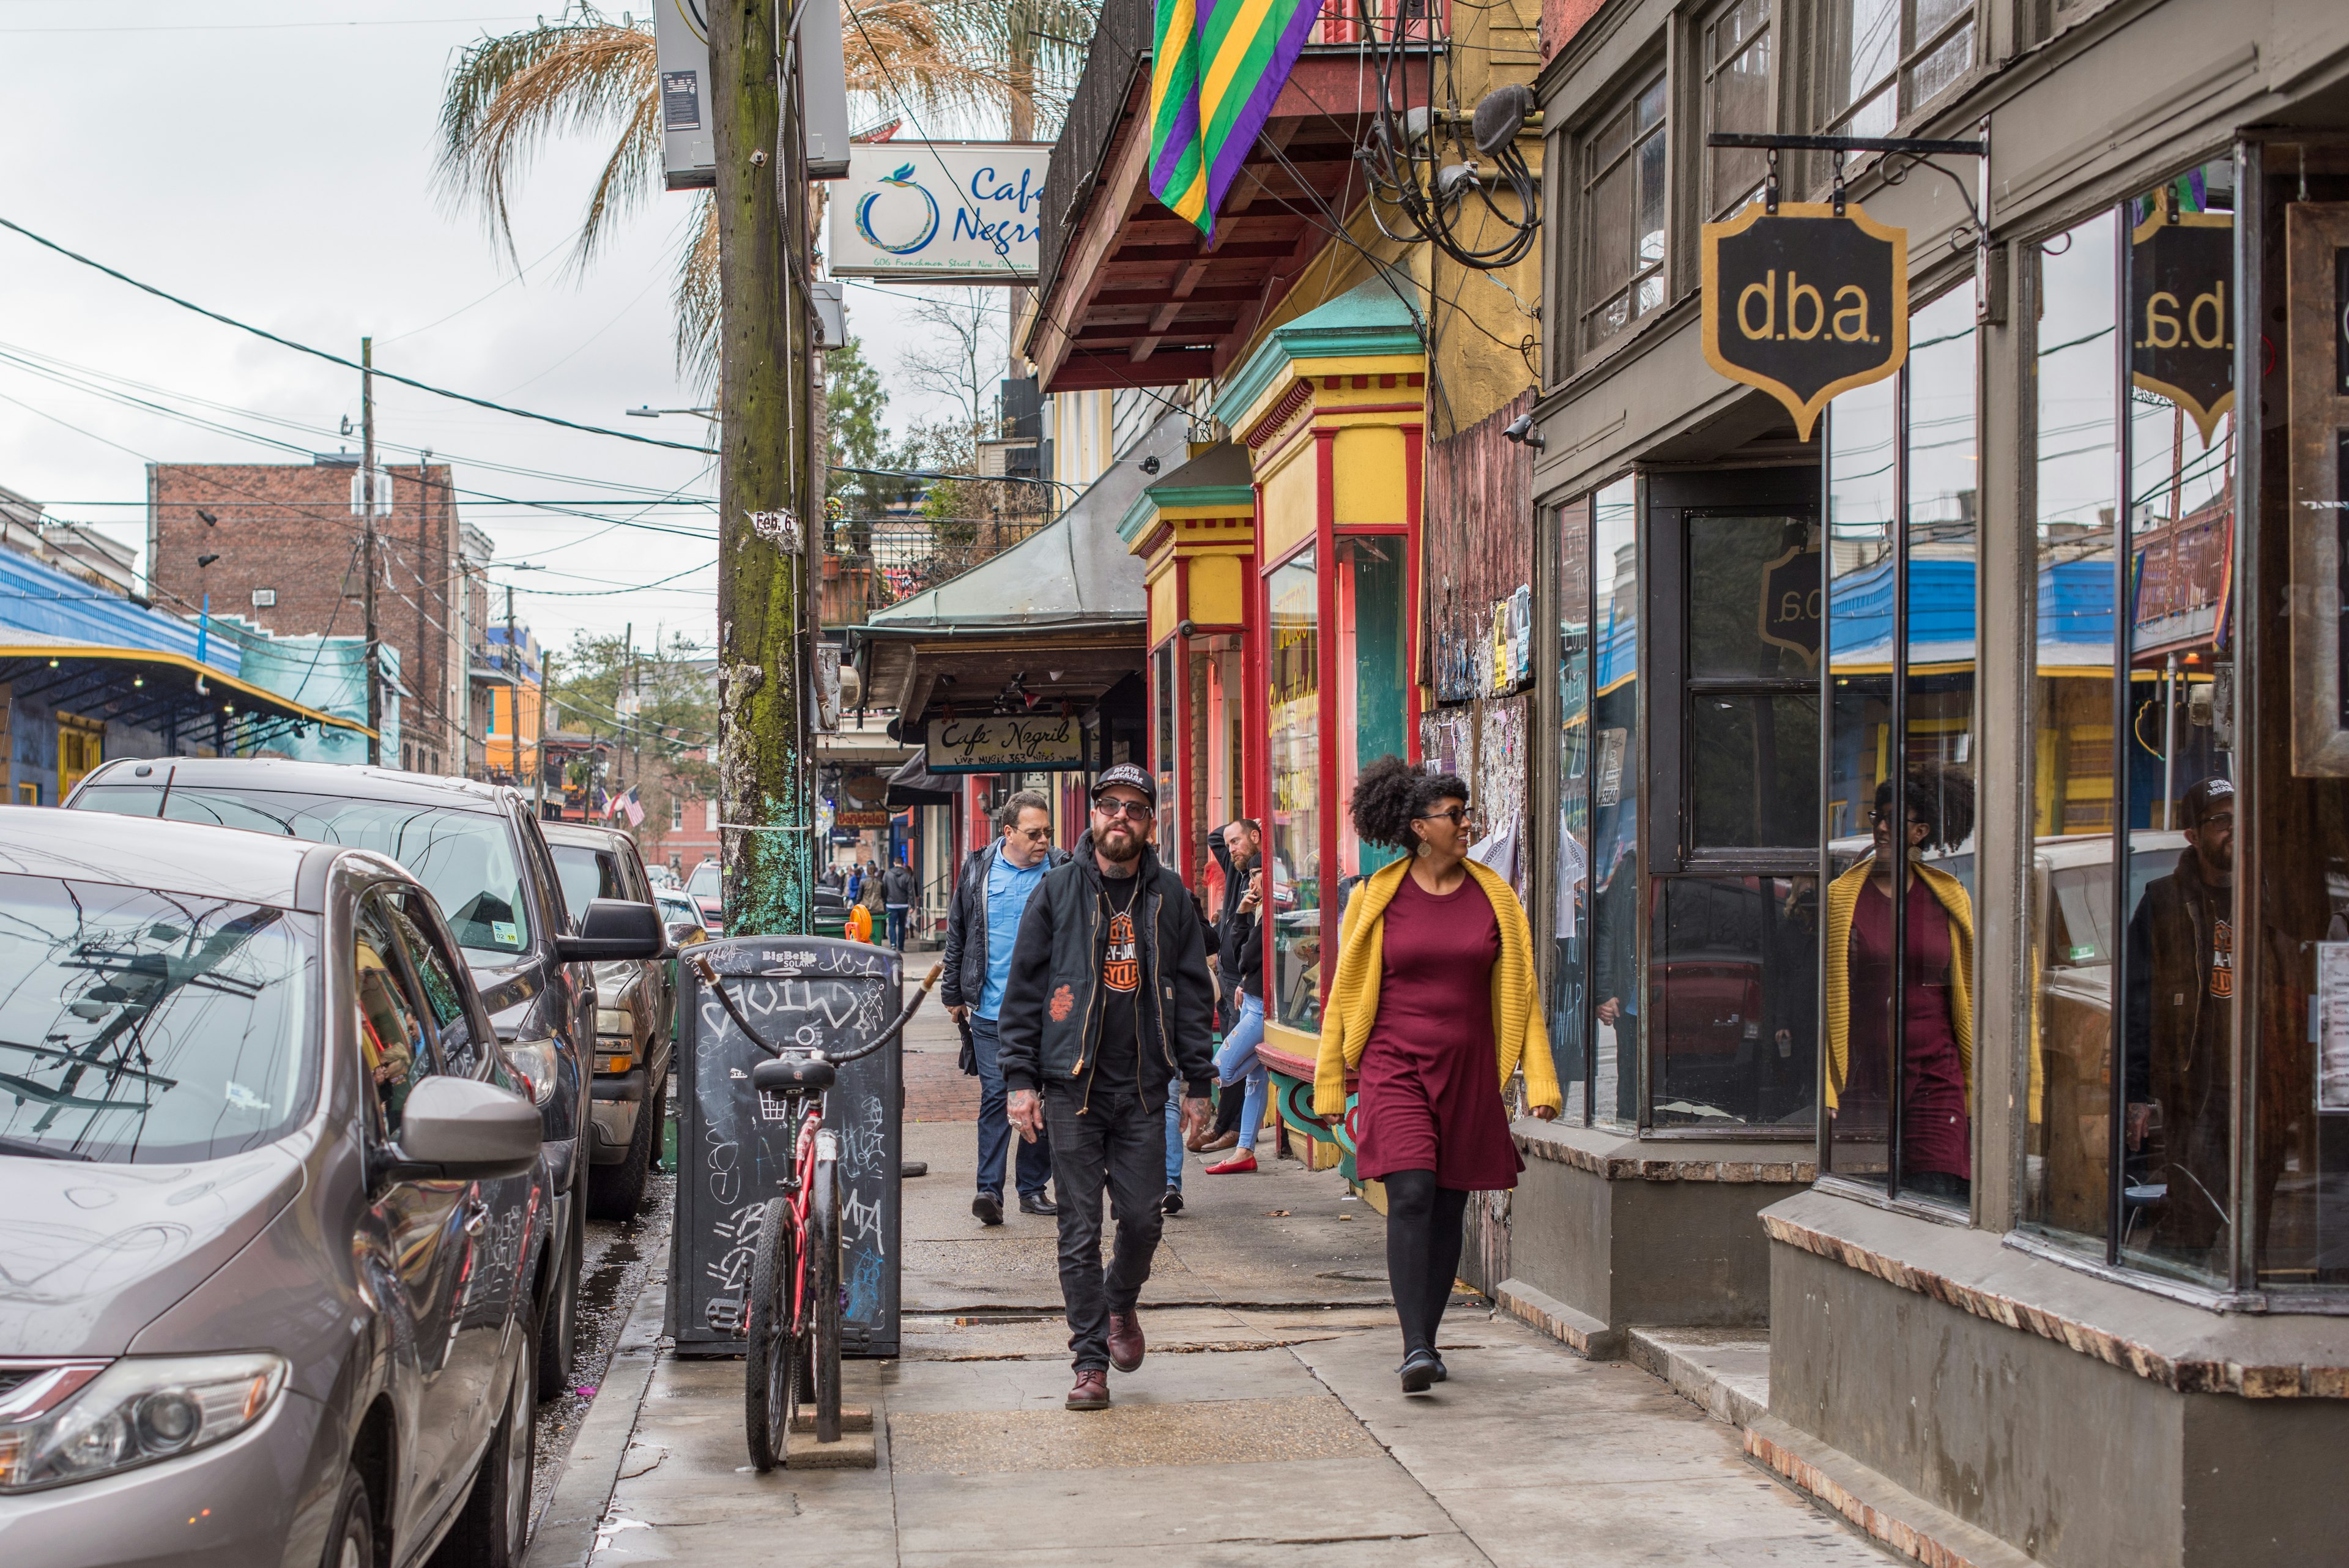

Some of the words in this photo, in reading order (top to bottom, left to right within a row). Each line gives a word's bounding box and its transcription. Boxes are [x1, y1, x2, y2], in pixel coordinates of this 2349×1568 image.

[953, 207, 1039, 255] Negri
[874, 258, 891, 266] 606
[896, 258, 943, 267] Frenchmen
[949, 258, 971, 267] Street
[979, 260, 993, 269] New
[1737, 270, 1880, 343] d.b.a.
[756, 513, 781, 531] Feb.
[1275, 579, 1308, 650] TATTOO
[1001, 720, 1070, 757] Negril
[1009, 753, 1027, 764] 363
